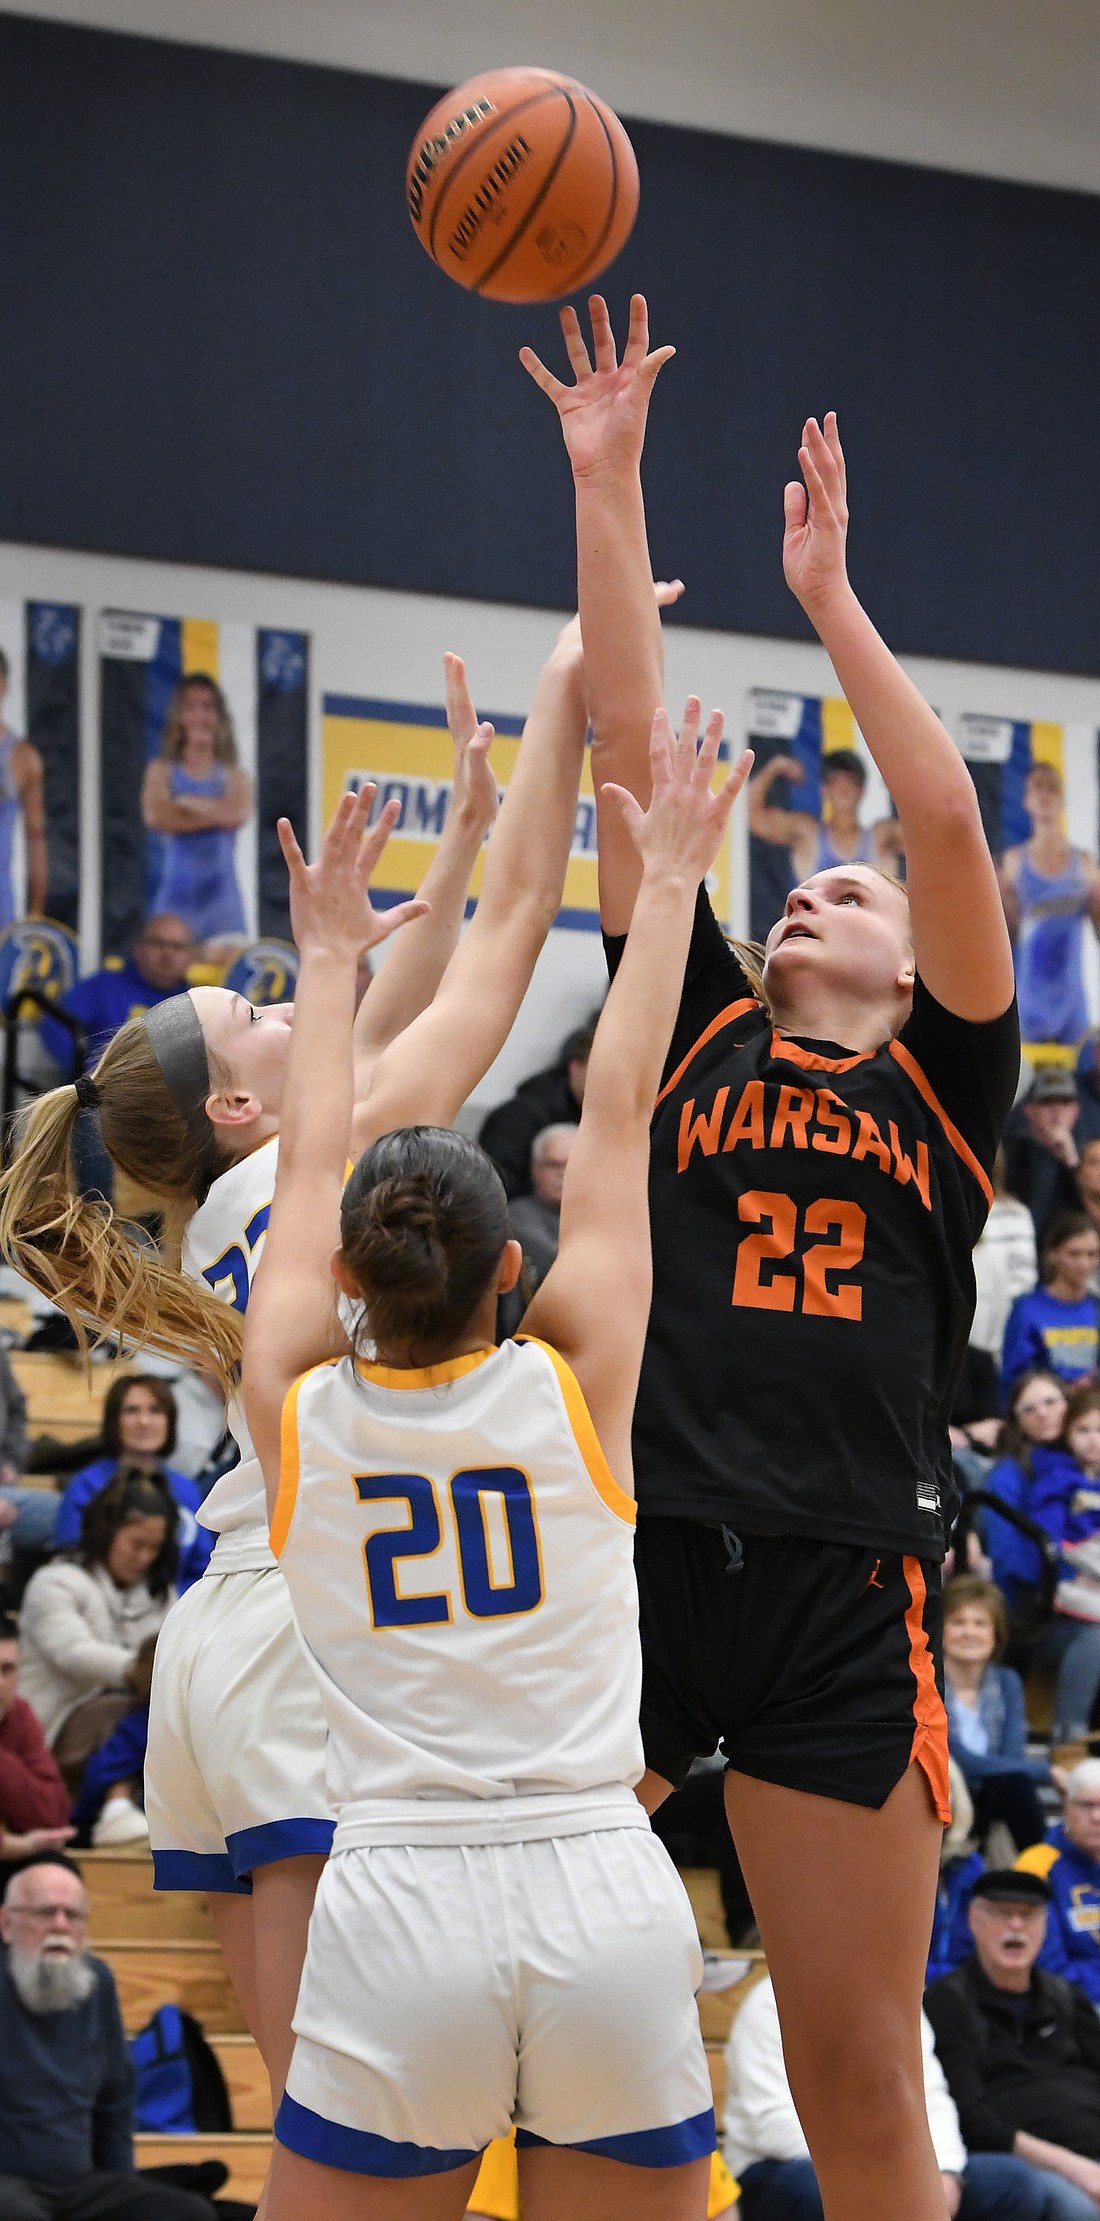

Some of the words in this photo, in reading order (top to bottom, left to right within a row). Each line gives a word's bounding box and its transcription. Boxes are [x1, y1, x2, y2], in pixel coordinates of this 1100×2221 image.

[448, 136, 531, 260] EVOLUTION
[677, 1080, 932, 1211] WARSAW
[732, 1190, 867, 1322] 22
[351, 1463, 546, 1631] 20
